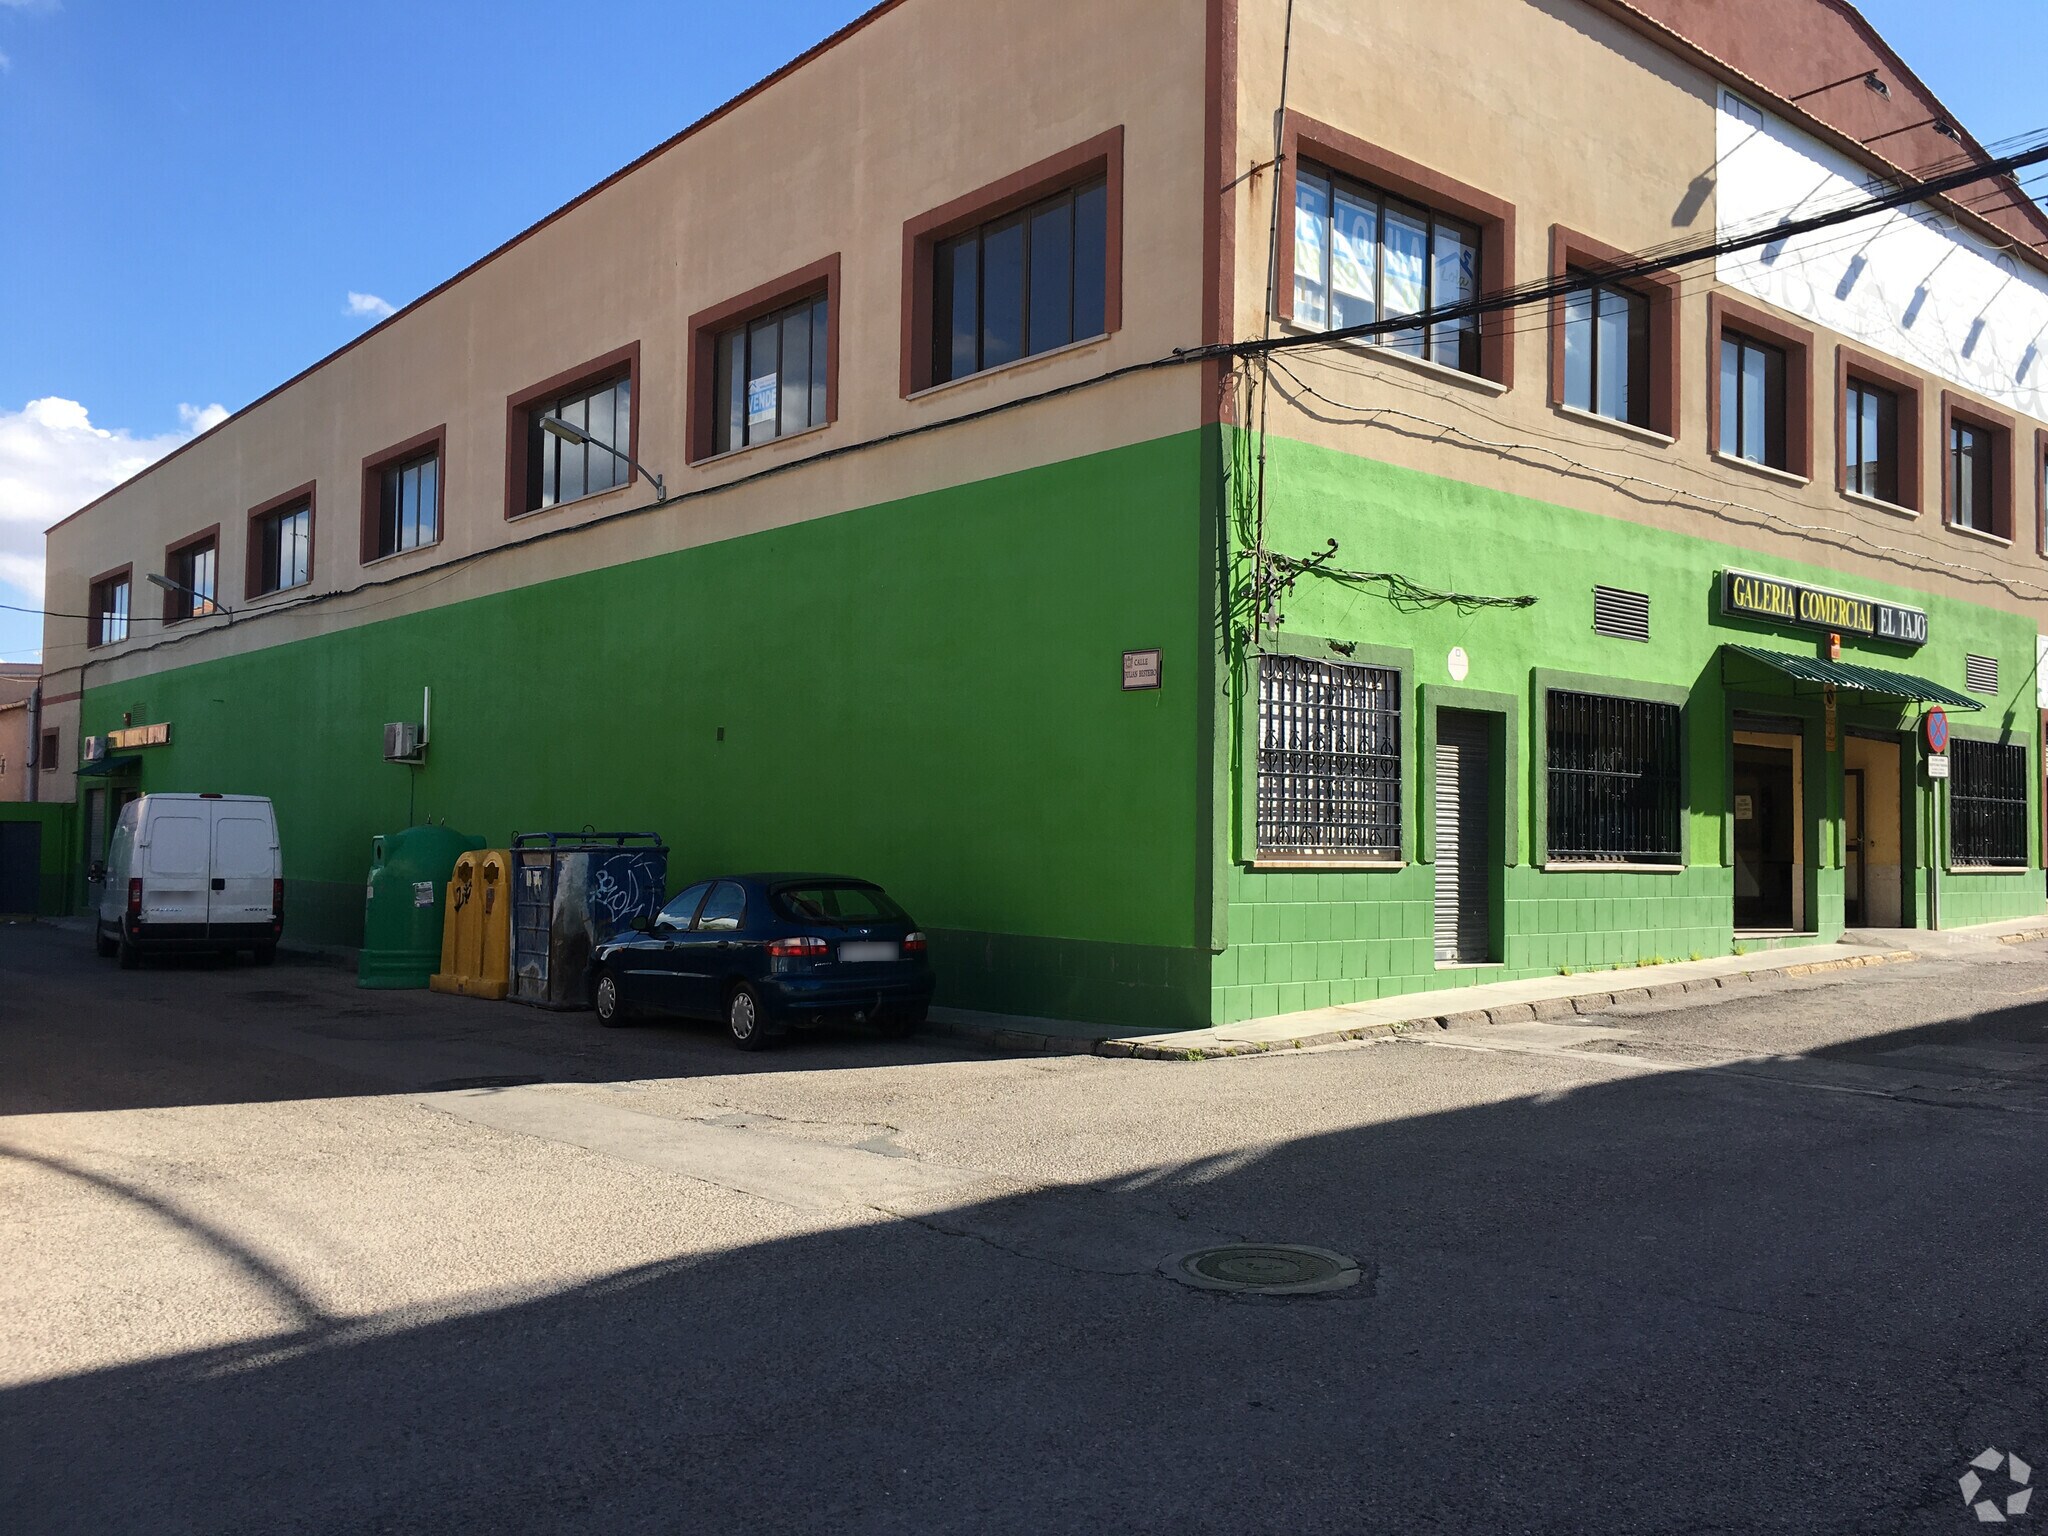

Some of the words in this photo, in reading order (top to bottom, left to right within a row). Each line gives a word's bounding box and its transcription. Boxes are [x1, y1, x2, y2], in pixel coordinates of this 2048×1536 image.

[1733, 576, 1795, 617] GALERIA
[1800, 590, 1874, 632] COMERCIAL
[1880, 606, 1896, 636] EL
[1899, 611, 1926, 641] TAJO
[1134, 658, 1148, 666] CALLE
